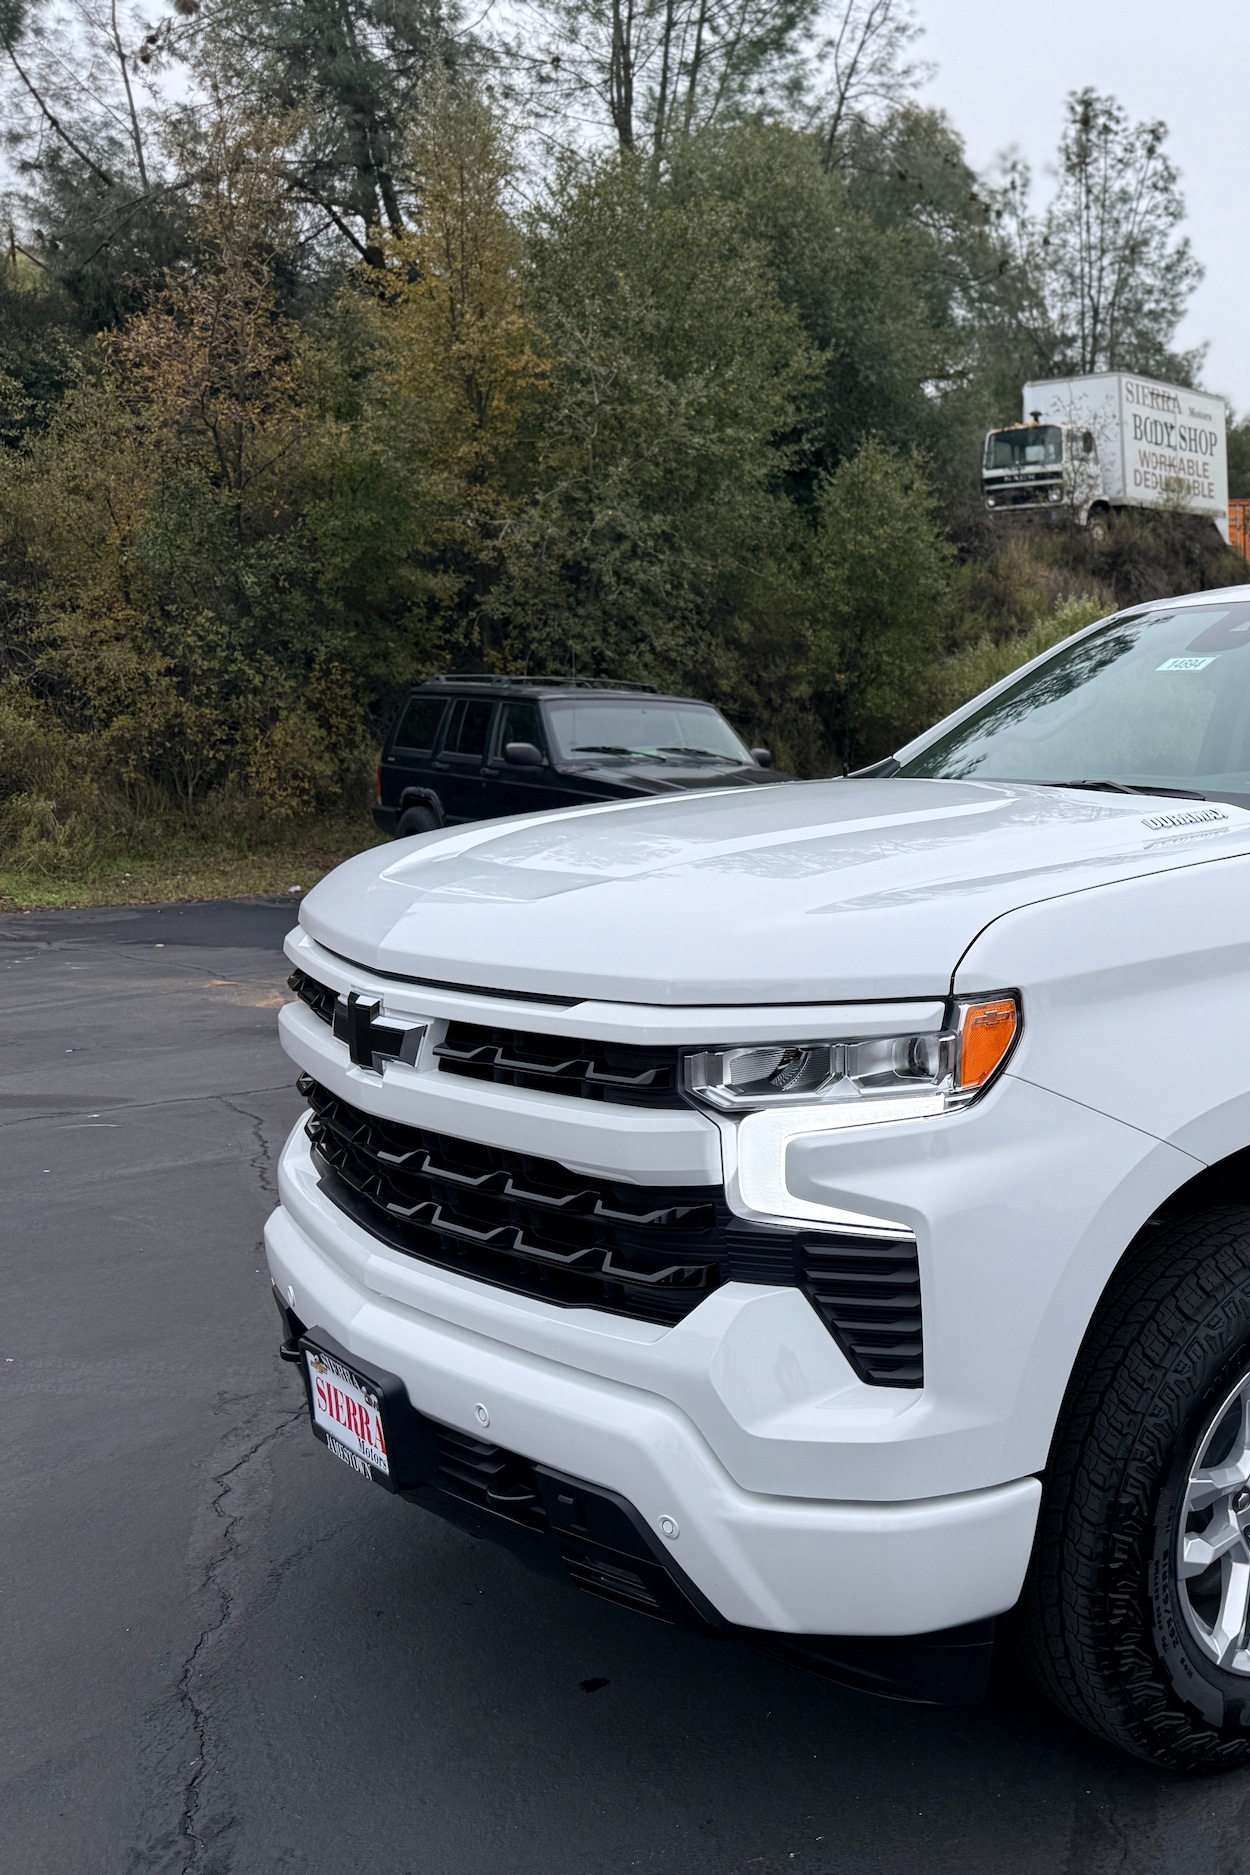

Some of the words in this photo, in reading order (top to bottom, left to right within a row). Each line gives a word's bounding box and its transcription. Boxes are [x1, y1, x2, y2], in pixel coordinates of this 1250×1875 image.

[1125, 381, 1182, 415] SIERRA
[1188, 406, 1212, 422] Motors
[1132, 413, 1177, 451] BODY
[1179, 424, 1218, 457] SHOP
[1138, 449, 1210, 480] WORKABLE
[1167, 658, 1207, 669] 14894
[1141, 807, 1229, 831] DURAMAX
[320, 1353, 361, 1391] SIERRA
[316, 1376, 388, 1455] SIERRA
[325, 1433, 373, 1481] JAMESTOWN
[357, 1438, 388, 1471] Motors
